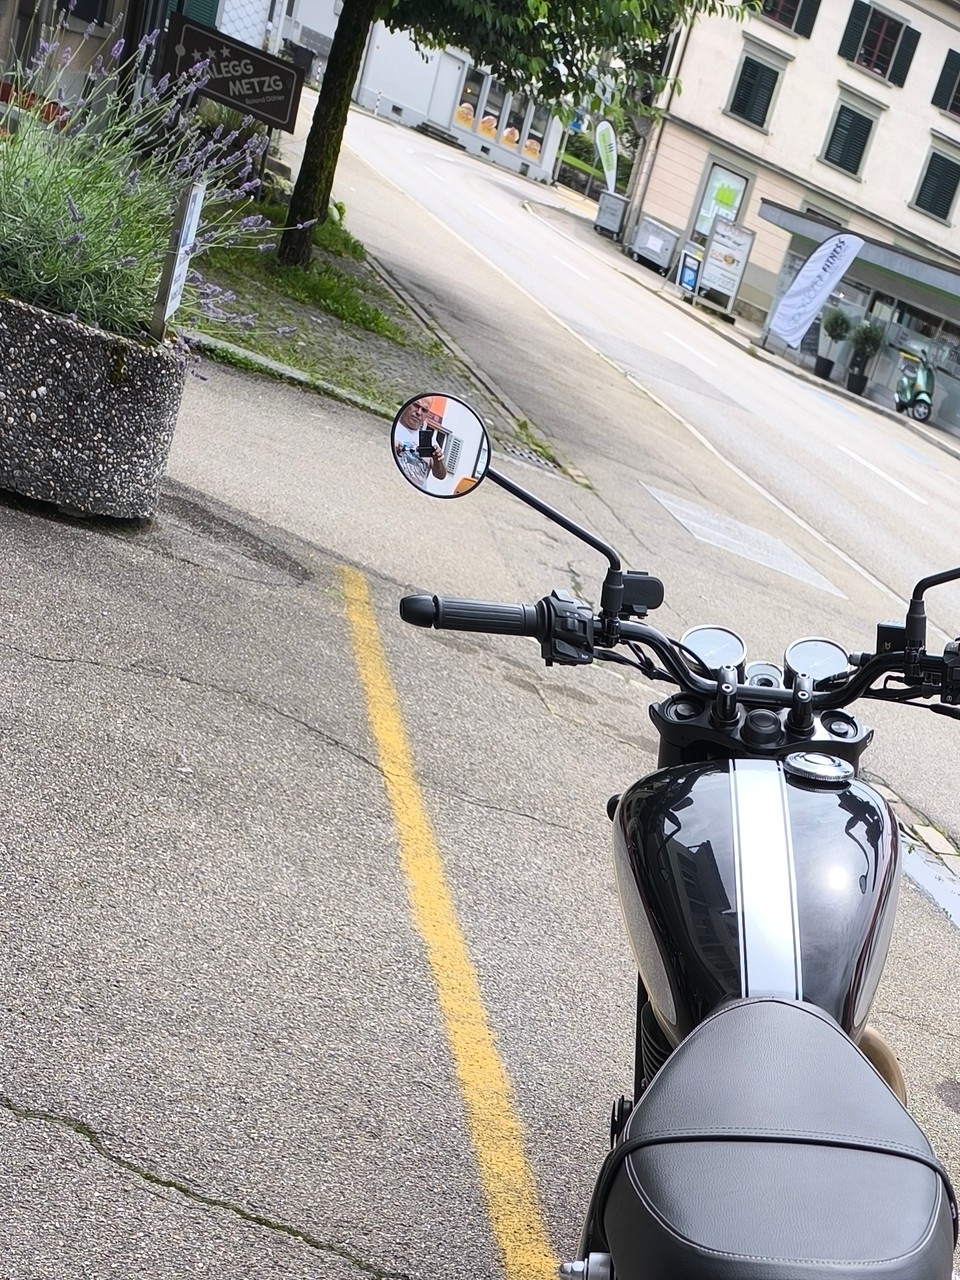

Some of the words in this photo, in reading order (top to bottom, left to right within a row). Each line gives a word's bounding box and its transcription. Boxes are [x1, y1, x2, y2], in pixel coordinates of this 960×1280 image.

[201, 59, 254, 79] ALEGG
[228, 75, 283, 97] METZG
[822, 238, 846, 273] FITNESS
